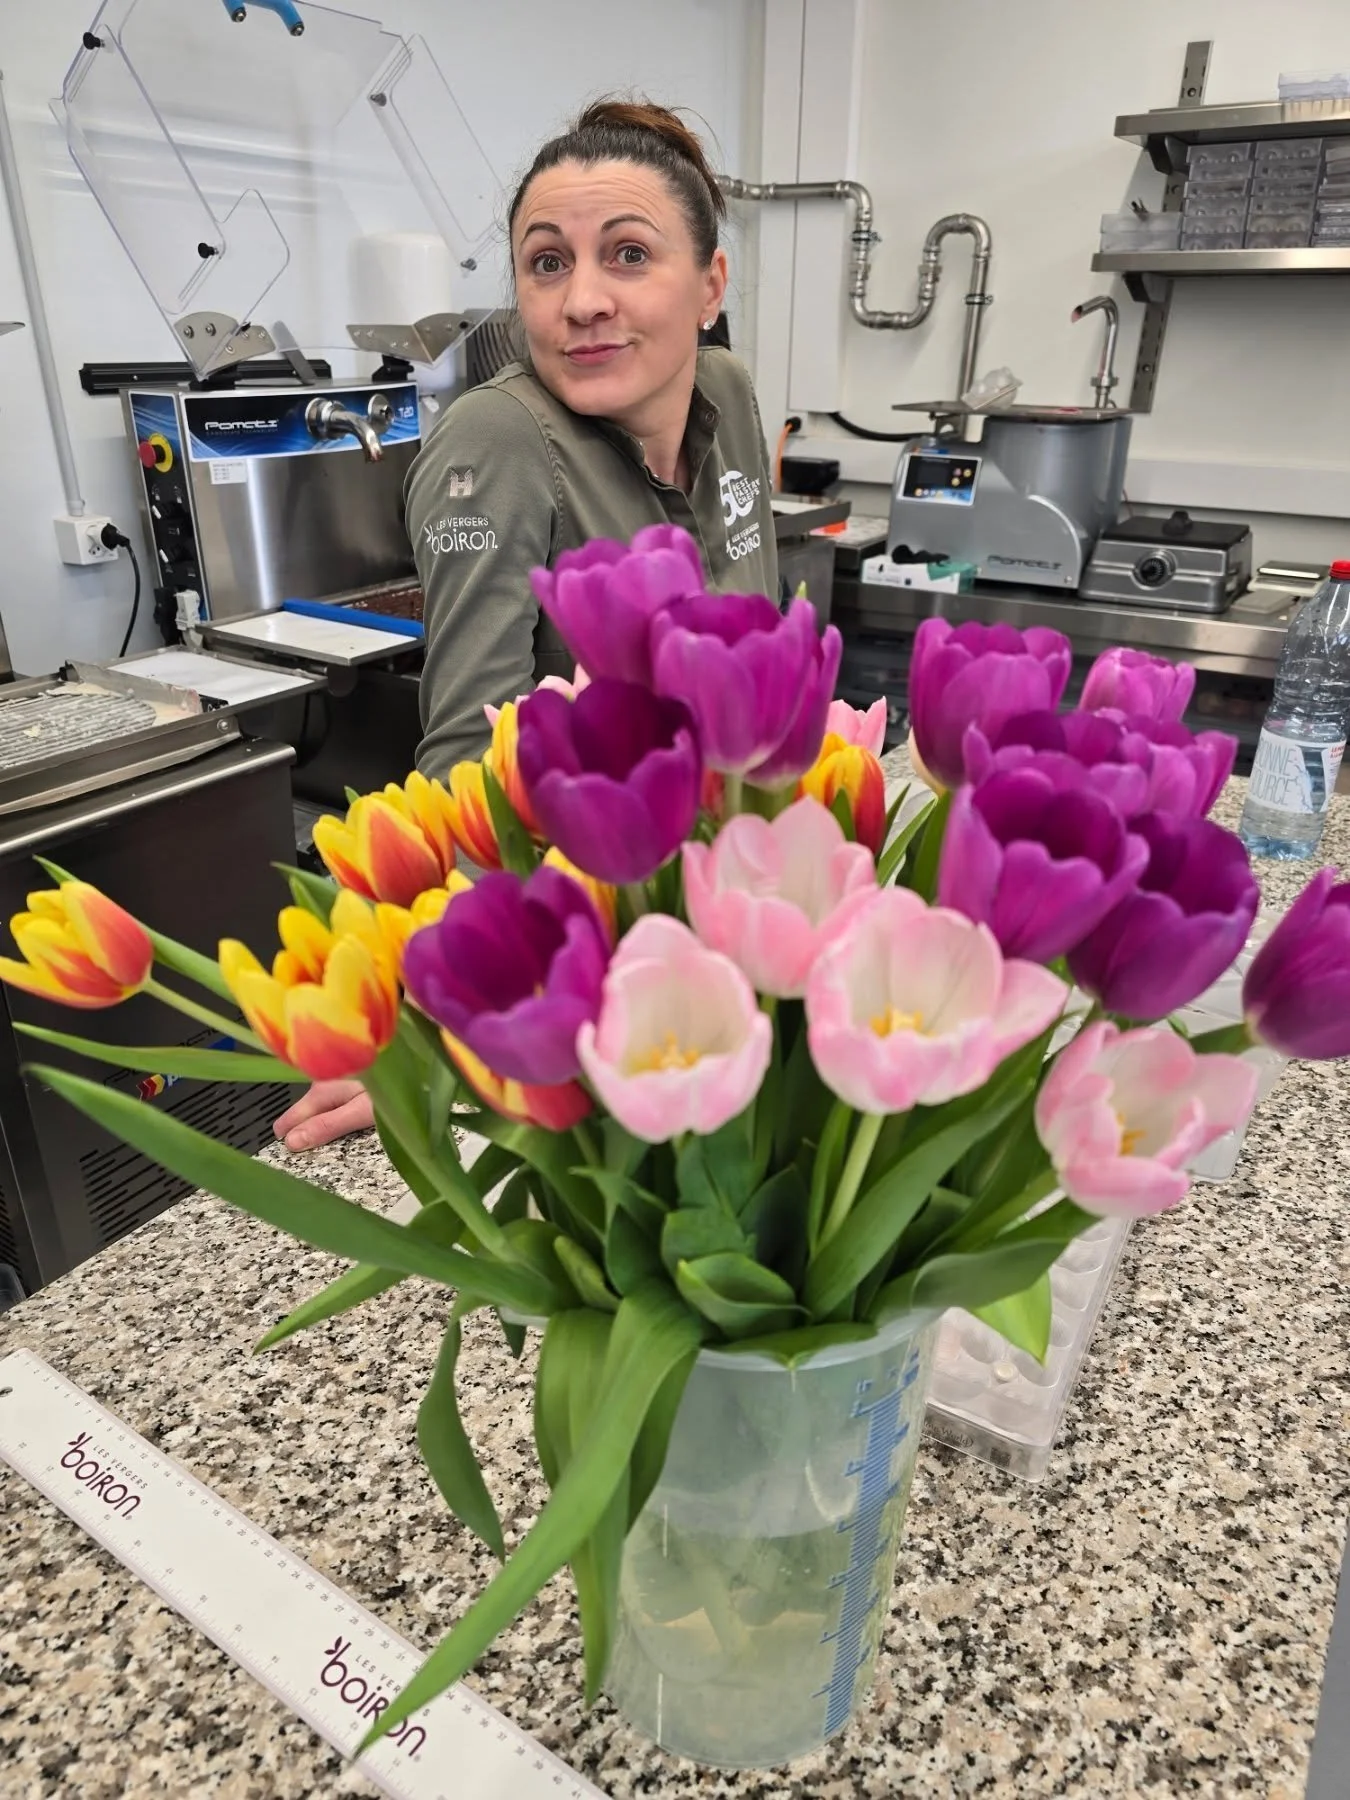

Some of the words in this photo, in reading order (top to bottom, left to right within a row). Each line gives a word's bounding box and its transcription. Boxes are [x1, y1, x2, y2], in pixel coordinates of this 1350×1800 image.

[436, 519, 447, 531] LES
[447, 516, 489, 528] VERGERS
[727, 533, 760, 560] boiro
[1249, 768, 1298, 806] OURCE
[93, 1445, 110, 1458] LES
[111, 1459, 148, 1489] VERGERS
[334, 1604, 344, 1613] 27
[364, 1628, 375, 1637] 29
[380, 1640, 390, 1649] 30
[396, 1653, 405, 1661] 31
[355, 1654, 377, 1673] LES
[380, 1673, 430, 1717] VERS
